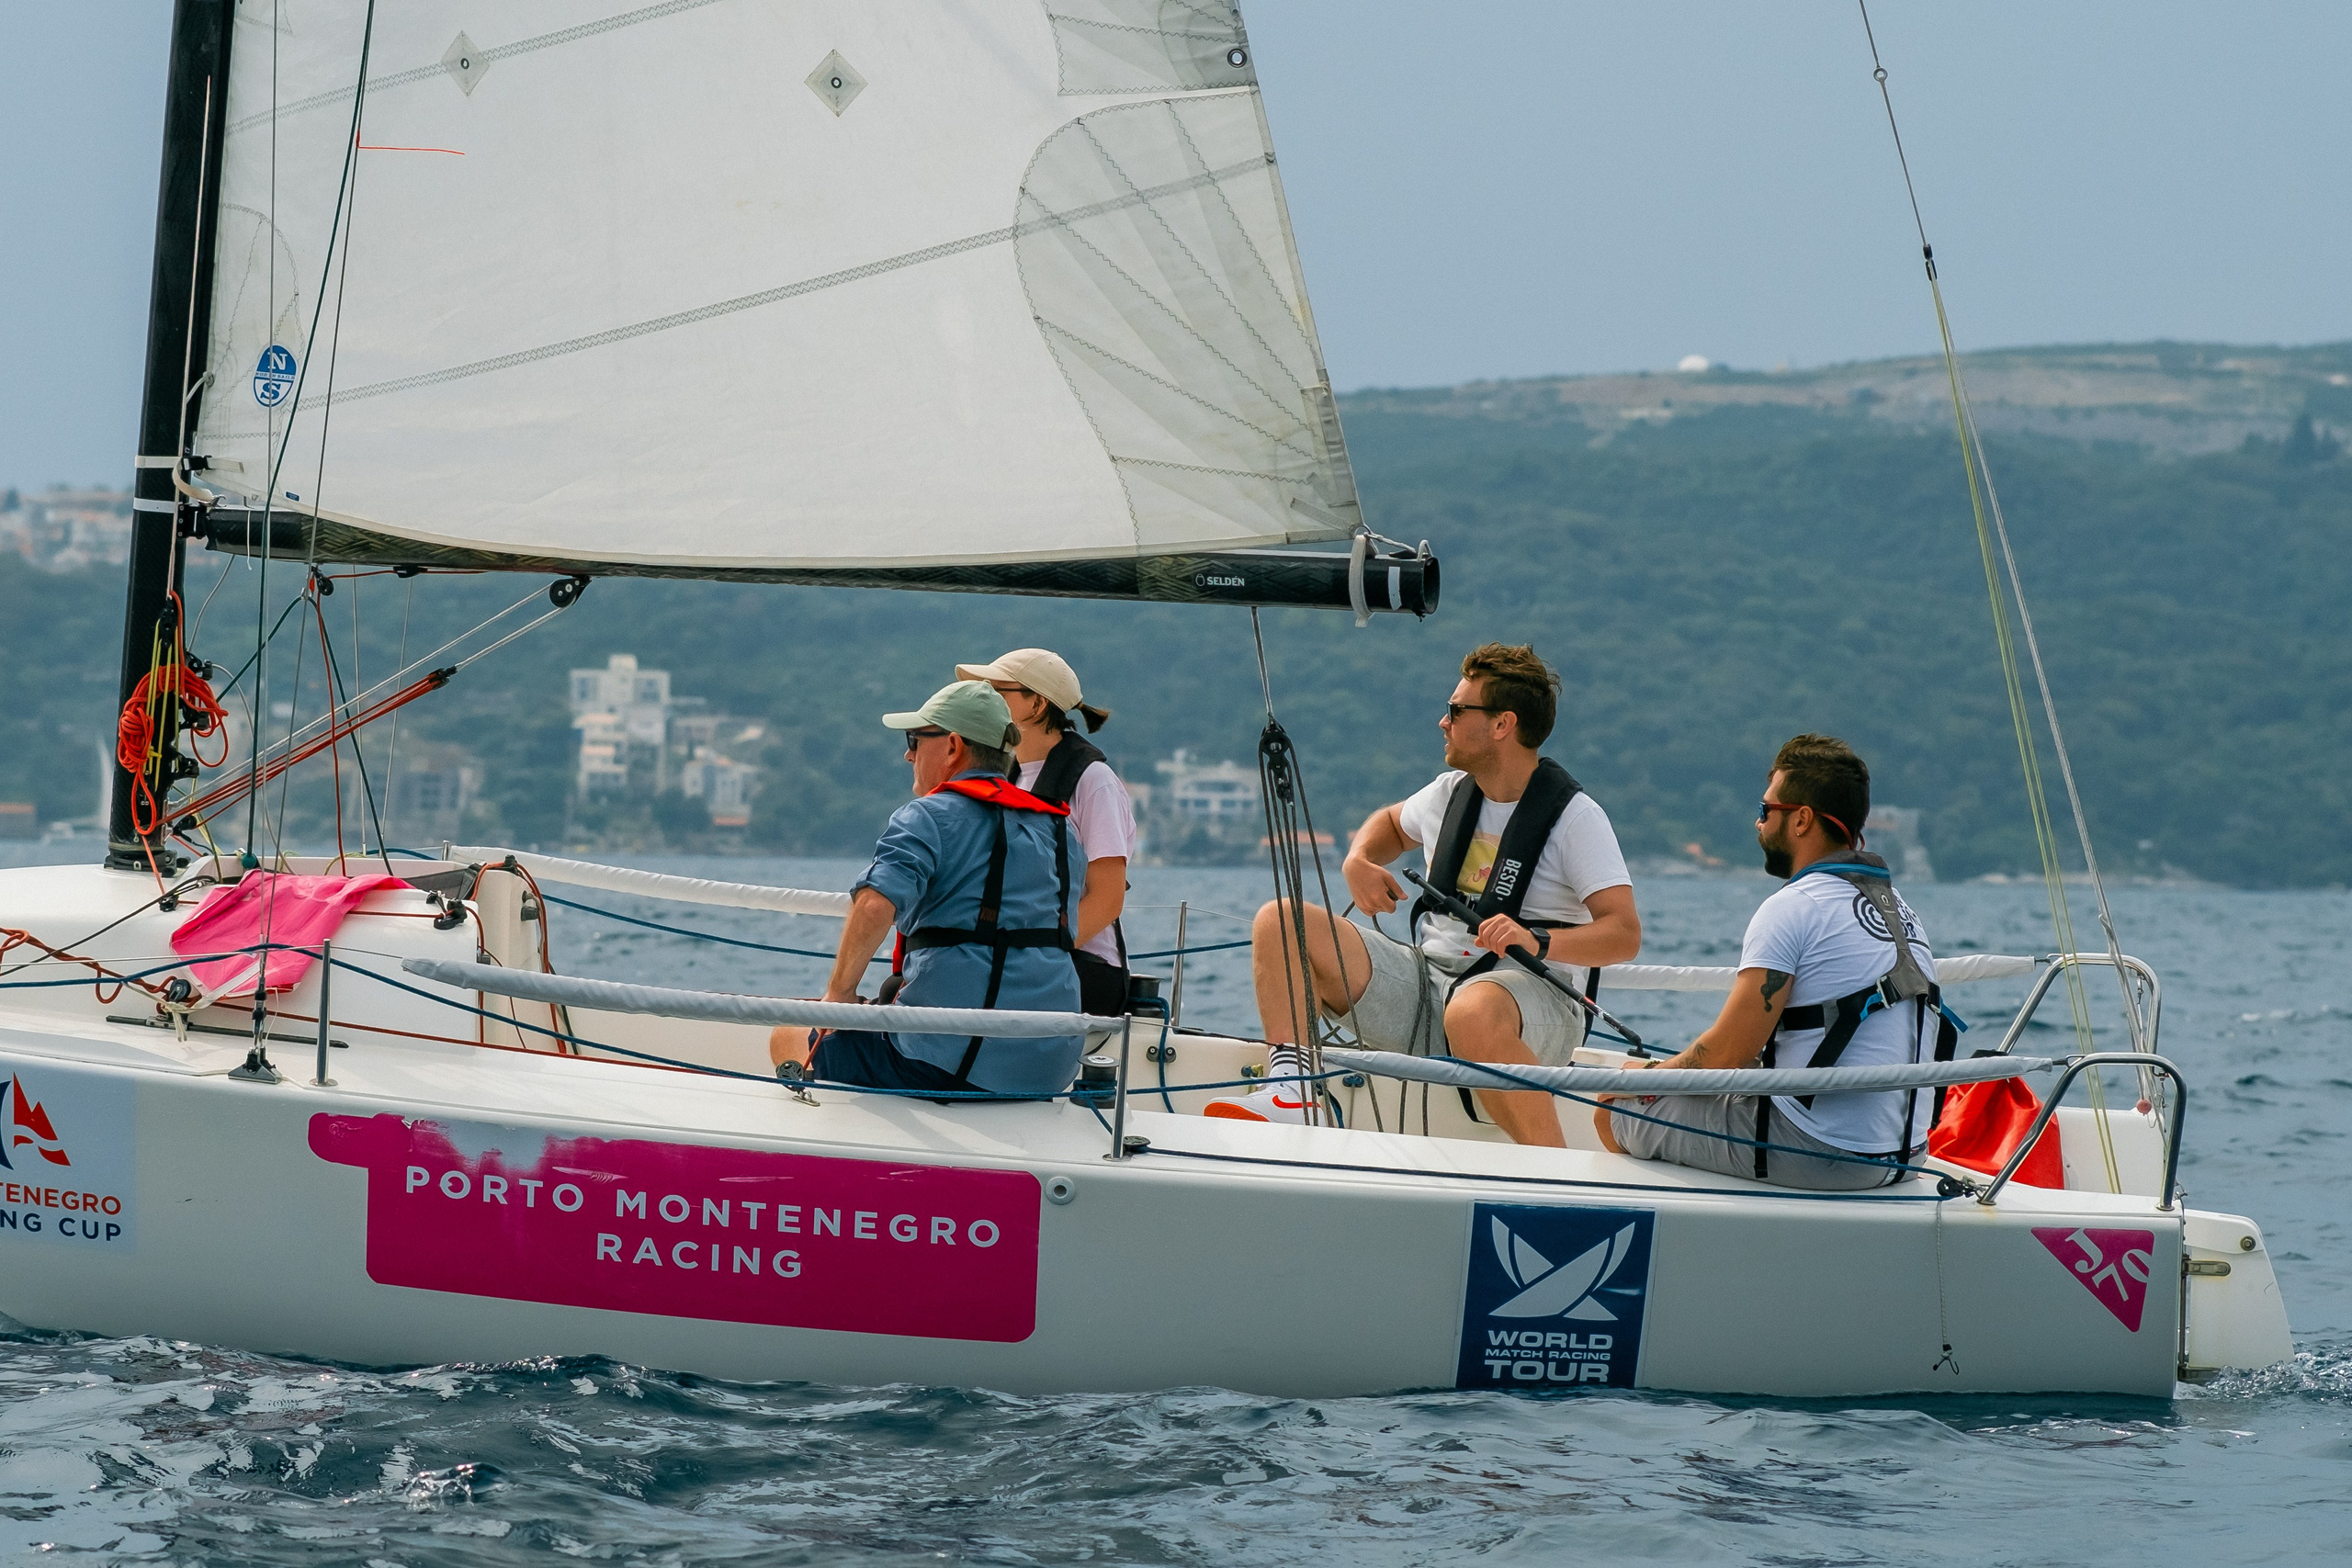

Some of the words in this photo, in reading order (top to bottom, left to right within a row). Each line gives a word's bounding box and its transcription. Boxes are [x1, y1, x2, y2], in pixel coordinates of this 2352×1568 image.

[260, 382, 281, 400] S
[1206, 575, 1245, 586] SELDÉN
[1495, 859, 1522, 897] BESTO
[0, 1181, 121, 1215] ENEGRO
[406, 1166, 584, 1213] PORTO
[616, 1190, 1000, 1247] MONTENEGRO
[59, 1217, 121, 1242] CUP
[596, 1233, 802, 1279] RACING
[1487, 1330, 1612, 1349] WORLD
[1485, 1348, 1544, 1359] MATCH
[1548, 1350, 1611, 1360] RACING
[1484, 1359, 1610, 1382] TOUR
